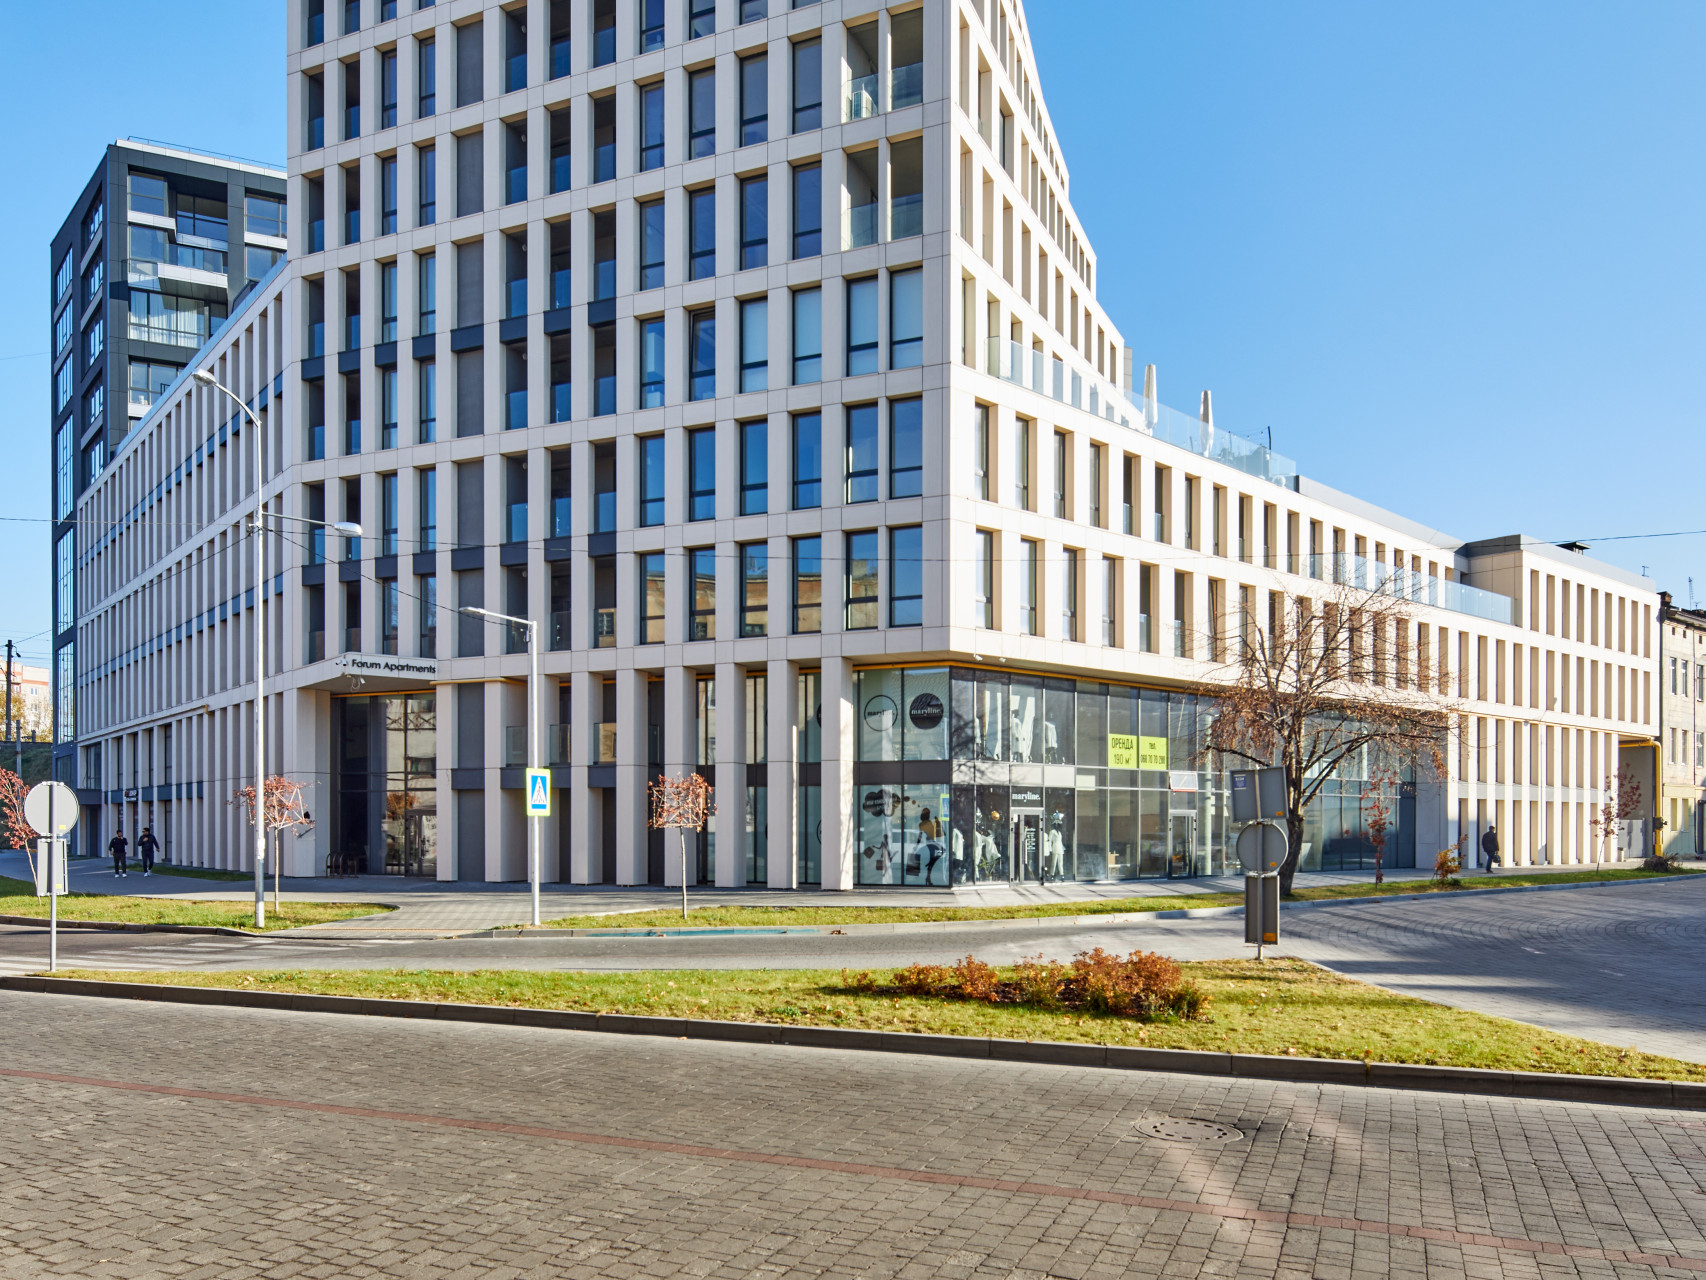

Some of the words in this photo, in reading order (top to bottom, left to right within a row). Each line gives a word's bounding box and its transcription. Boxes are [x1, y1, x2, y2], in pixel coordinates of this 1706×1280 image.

[352, 659, 381, 669] Forum
[383, 662, 436, 673] Apartments
[1112, 738, 1133, 750] ОРЕНДА
[1114, 753, 1124, 765] 190
